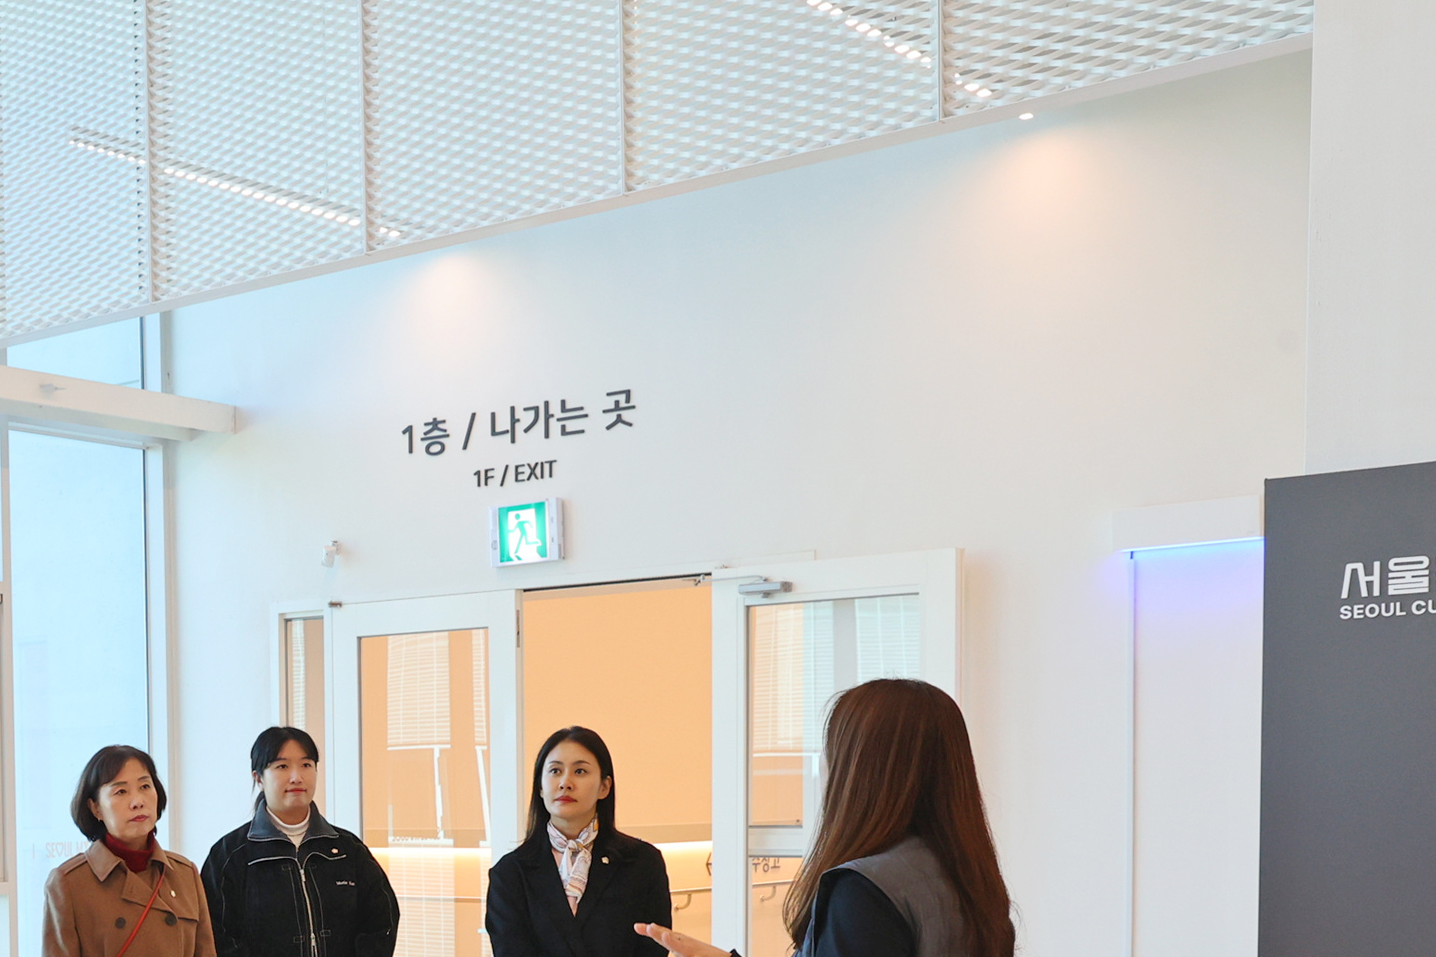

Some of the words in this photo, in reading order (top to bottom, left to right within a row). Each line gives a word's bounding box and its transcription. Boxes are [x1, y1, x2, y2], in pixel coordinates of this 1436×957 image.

[401, 417, 450, 456] 1층
[462, 412, 476, 451] /
[490, 399, 589, 444] 나가는
[602, 389, 636, 430] 곳
[473, 468, 495, 488] 1F
[500, 464, 509, 487] /
[514, 460, 558, 483] EXIT
[1340, 555, 1430, 600] 서울
[1339, 601, 1407, 620] SEOUL
[1411, 599, 1436, 615] CU
